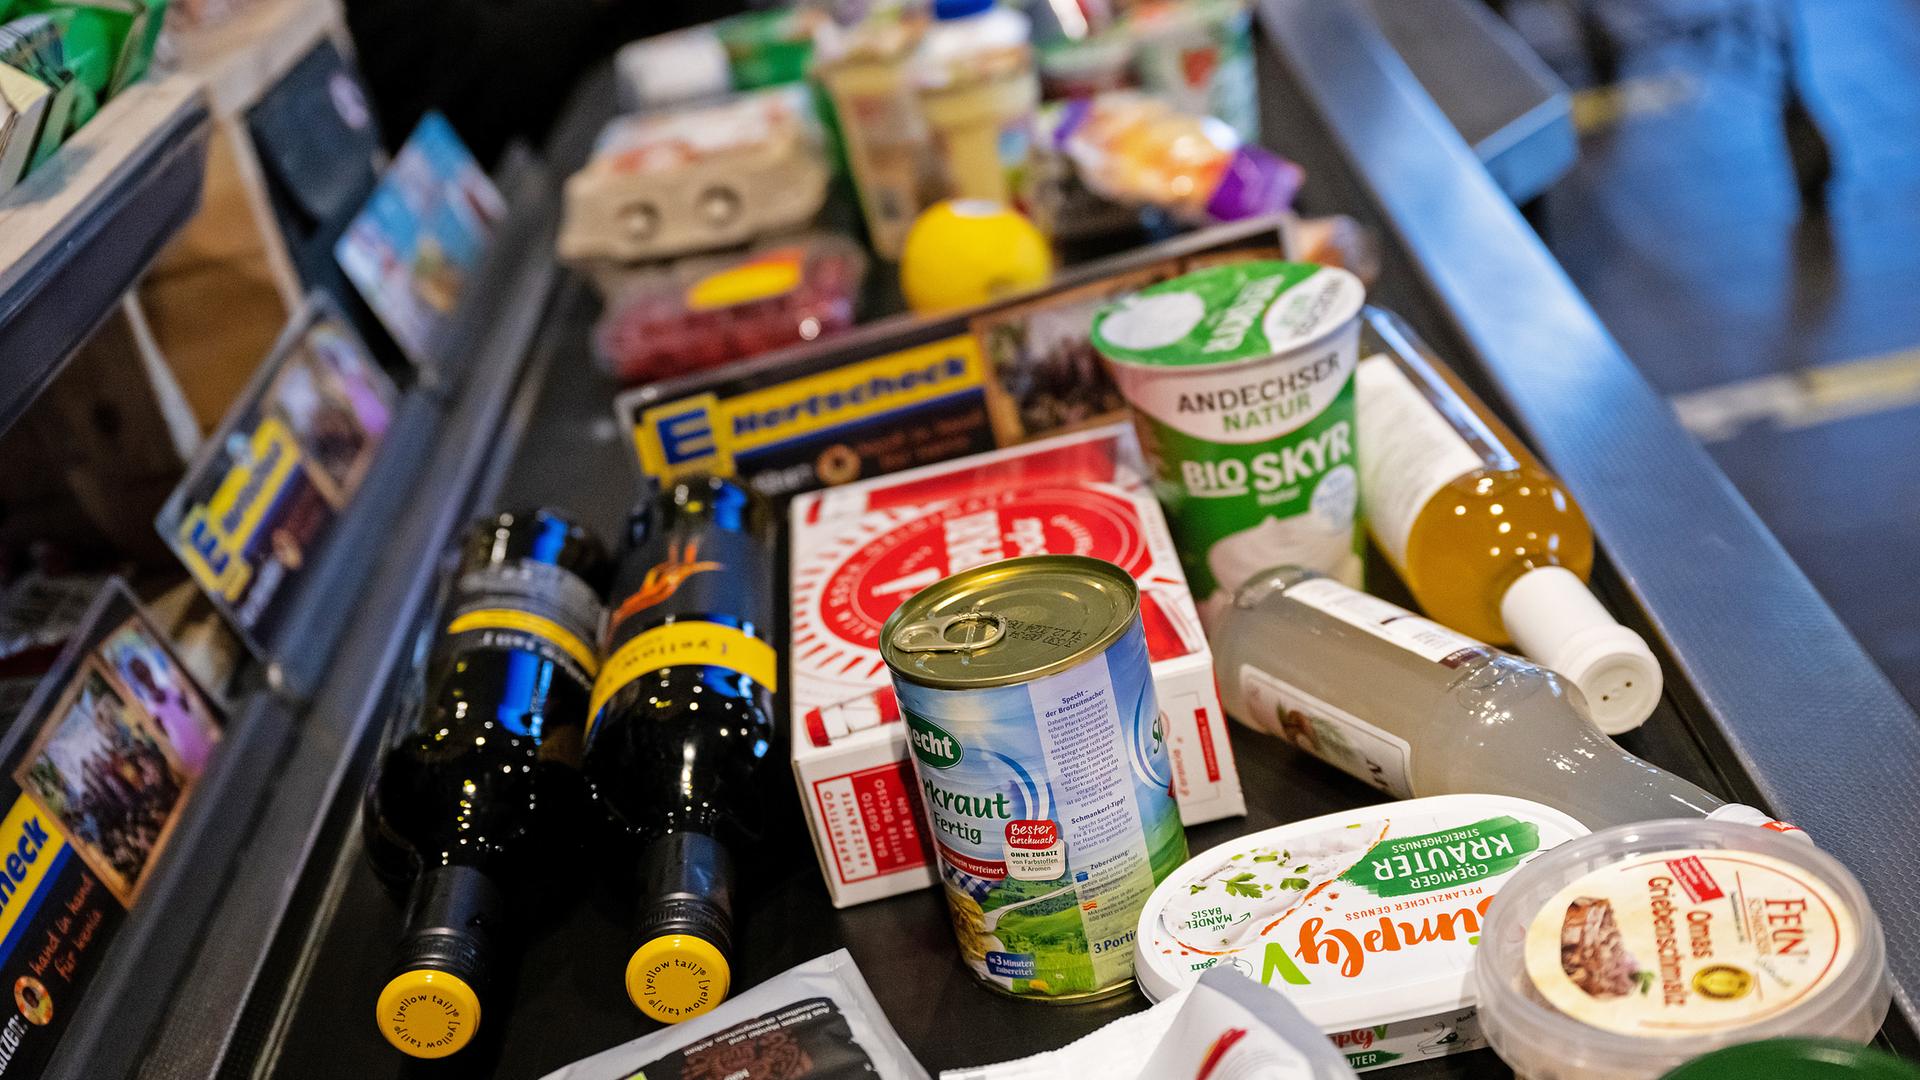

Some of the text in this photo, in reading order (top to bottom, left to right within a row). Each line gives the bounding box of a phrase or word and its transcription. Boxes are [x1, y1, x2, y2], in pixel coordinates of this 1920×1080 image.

[1177, 353, 1340, 414] ANDECHSER
[1222, 393, 1312, 432] NATUR
[1182, 421, 1350, 491] BIO SKYR
[1045, 689, 1104, 718] der Brotzeitmacher
[1062, 690, 1084, 704] Specht
[912, 728, 954, 760] echt
[824, 791, 856, 875] L'APERITIVO
[841, 792, 870, 867] FRIZZANTE
[861, 792, 888, 858] DAL GUSTO
[902, 819, 914, 839] PER
[934, 812, 982, 845] Fertig
[1012, 824, 1052, 835] Bester
[888, 827, 905, 864] BITTER
[1010, 834, 1054, 844] Geschmack
[1392, 828, 1480, 853] STREICHGENUSS
[969, 863, 1005, 875] verfeinert
[1371, 833, 1514, 881] KRÄUTER
[1410, 863, 1488, 889] CREMIGER
[1192, 907, 1221, 919] BASIS
[1345, 887, 1482, 921] PFLANZLICHER GENUSS
[1185, 914, 1232, 929] MANDEL
[1212, 924, 1225, 932] AUF
[1687, 911, 1713, 958] Omas
[1094, 943, 1101, 953] 3
[1648, 877, 1689, 1006] Griebenschmalz
[996, 956, 1002, 965] 3
[1190, 958, 1218, 972] gan
[1350, 1055, 1377, 1066] UTER
